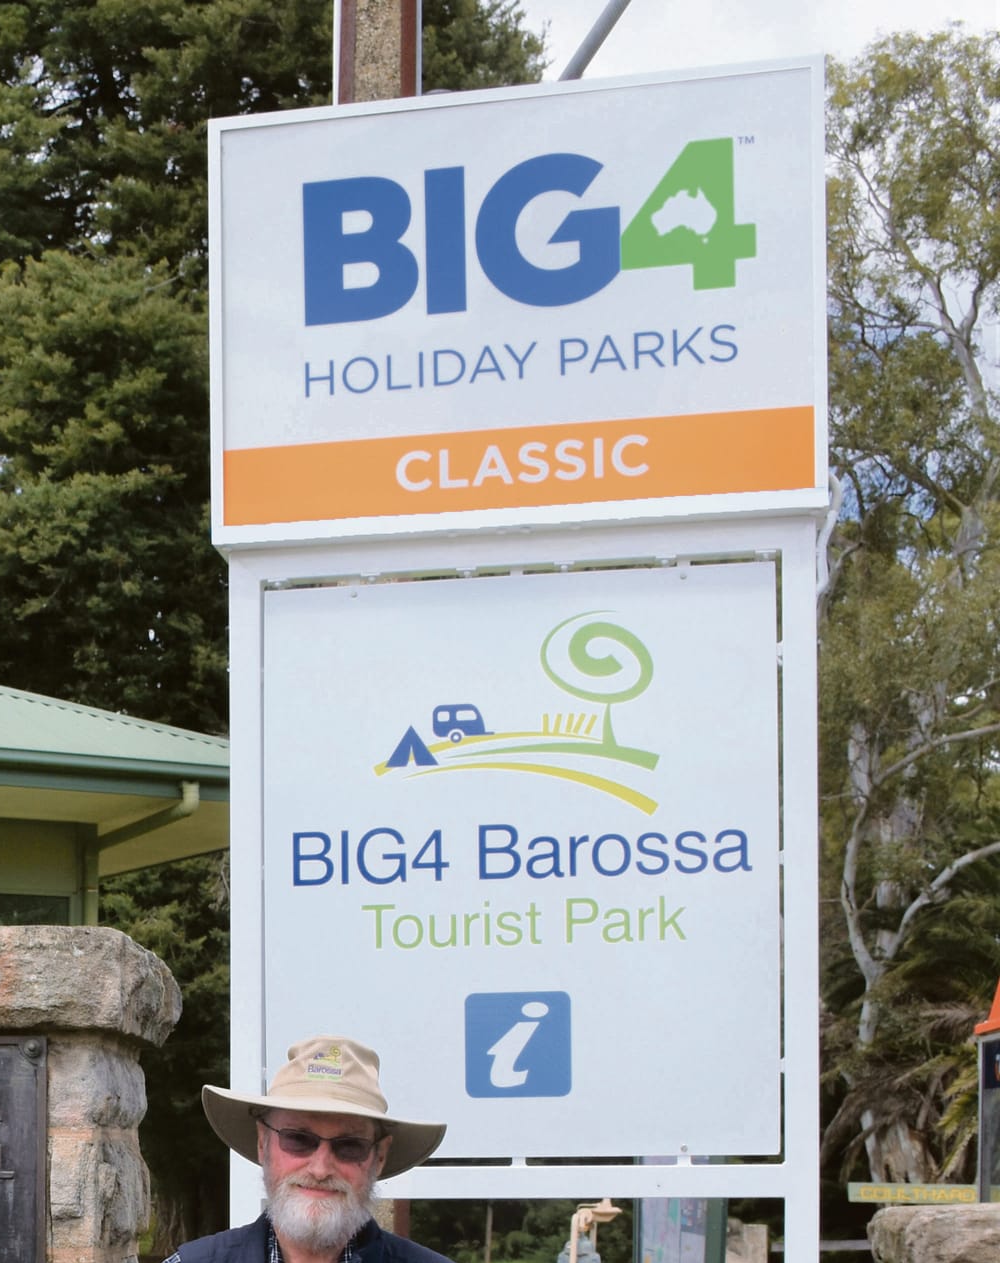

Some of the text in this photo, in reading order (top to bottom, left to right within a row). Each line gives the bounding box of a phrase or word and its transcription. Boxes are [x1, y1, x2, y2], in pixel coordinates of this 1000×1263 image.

[302, 136, 757, 327] BIG4
[304, 323, 739, 399] HOLIDAY PARKS
[396, 434, 650, 493] CLASSIC
[291, 824, 753, 887] BIG4 Barossa
[362, 895, 688, 950] Tourist Park
